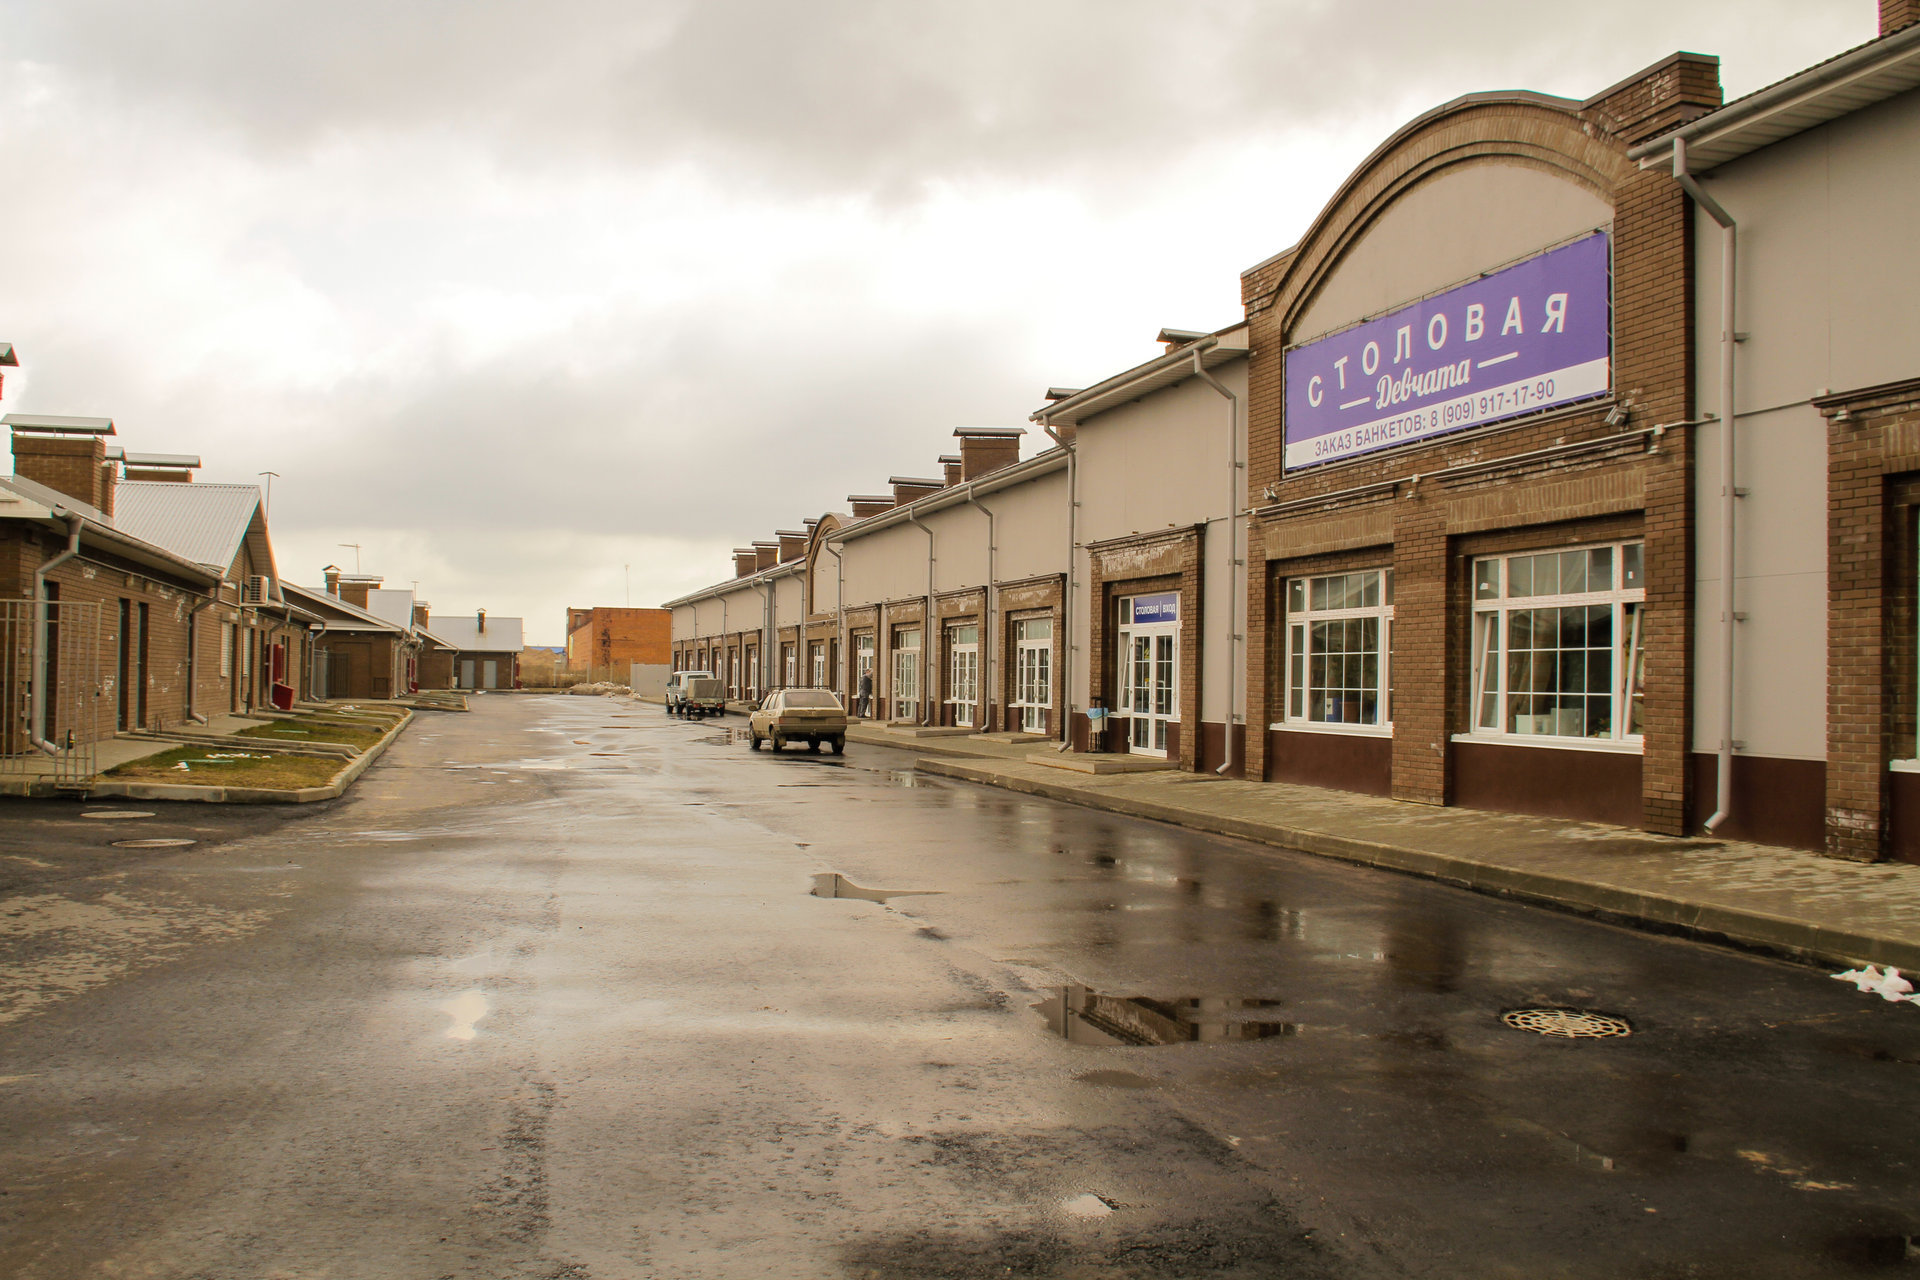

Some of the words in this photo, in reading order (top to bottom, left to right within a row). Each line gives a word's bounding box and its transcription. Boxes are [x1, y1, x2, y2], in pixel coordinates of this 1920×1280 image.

[1308, 293, 1568, 408] СТОЛОВАЯ
[1376, 359, 1471, 410] Девчата
[1315, 432, 1352, 457] ЗАКАЗ
[1355, 414, 1426, 447] БАНКЕТОВ:
[1430, 411, 1438, 426] 8
[1442, 398, 1475, 426] (909)
[1480, 378, 1555, 415] 917-17-90
[1135, 605, 1159, 616] СТОЛОВАЯ
[1162, 603, 1176, 614] ВХОД
